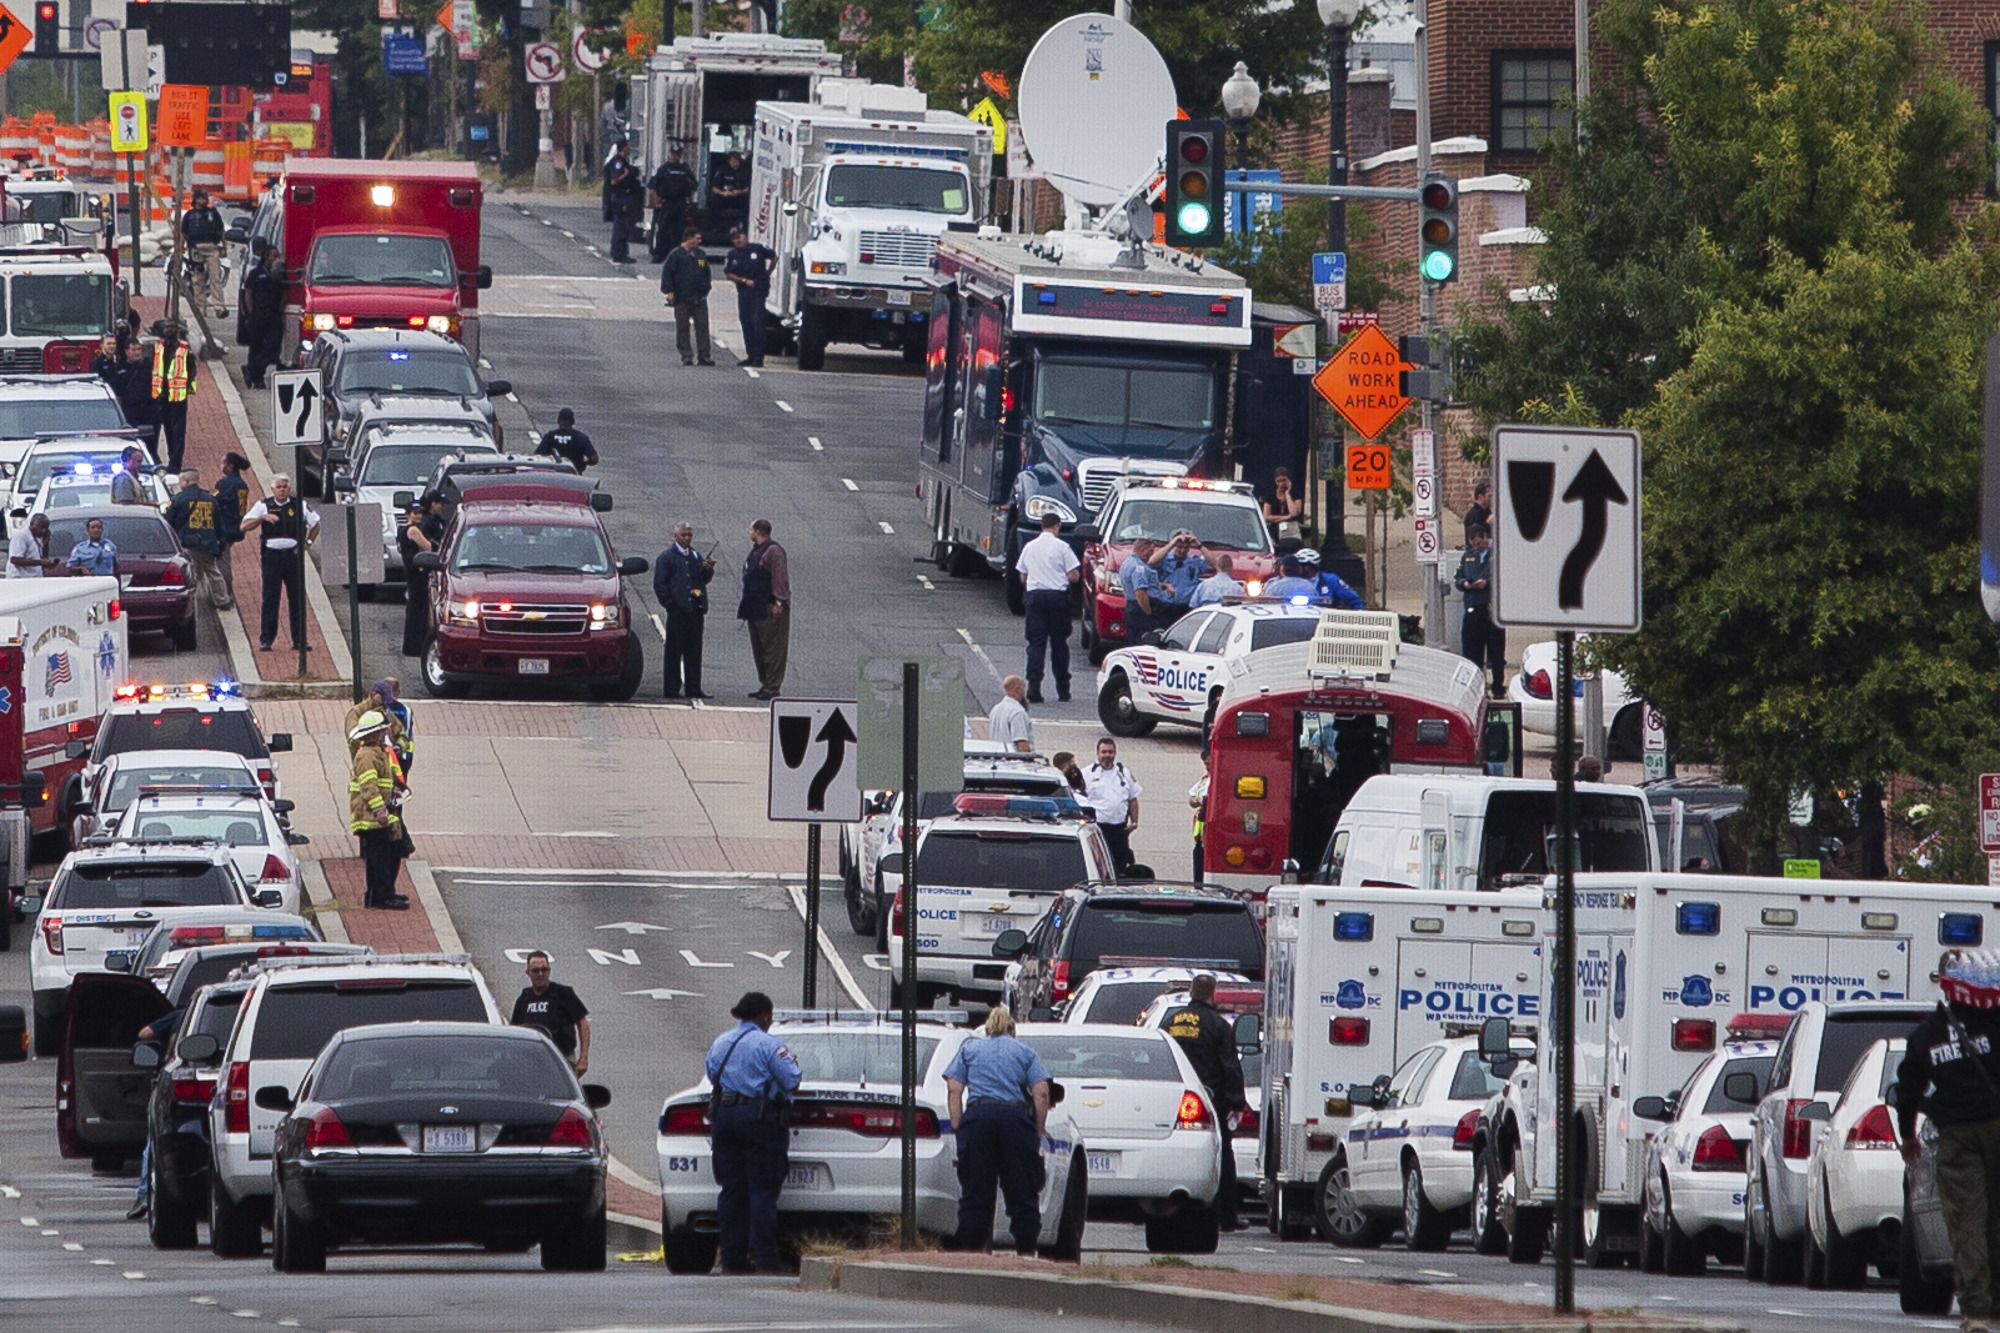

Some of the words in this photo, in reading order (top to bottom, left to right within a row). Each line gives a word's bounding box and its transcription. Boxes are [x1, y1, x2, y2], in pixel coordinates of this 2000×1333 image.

[169, 102, 199, 110] TRAFFIC
[171, 132, 191, 140] LANE
[1319, 286, 1340, 296] BUS
[1318, 297, 1343, 307] STOP
[1348, 352, 1395, 366] ROAD
[1348, 373, 1395, 387] WORK
[1345, 394, 1399, 409] AHEAD
[1352, 451, 1386, 471] 20
[1157, 668, 1207, 692] POLICE
[917, 888, 972, 896] ETROPOLITAN
[76, 914, 116, 923] DISTRICT
[1897, 942, 1906, 952] 4
[504, 948, 792, 968] ONLY
[1578, 960, 1608, 987] POLICE
[1435, 981, 1503, 992] METROPOLITAN
[1791, 974, 1865, 987] METROPOLITAN
[1320, 995, 1335, 1004] MP
[1367, 996, 1382, 1006] DC
[1400, 989, 1540, 1016] POLICE
[1662, 991, 1679, 1000] MP
[1715, 993, 1731, 1002] DC
[1425, 1013, 1492, 1021] WASHINGTO
[1928, 1043, 1962, 1066] FIRE
[816, 1090, 850, 1100] PARK
[854, 1092, 898, 1103] POLICE
[669, 1157, 698, 1172] 531
